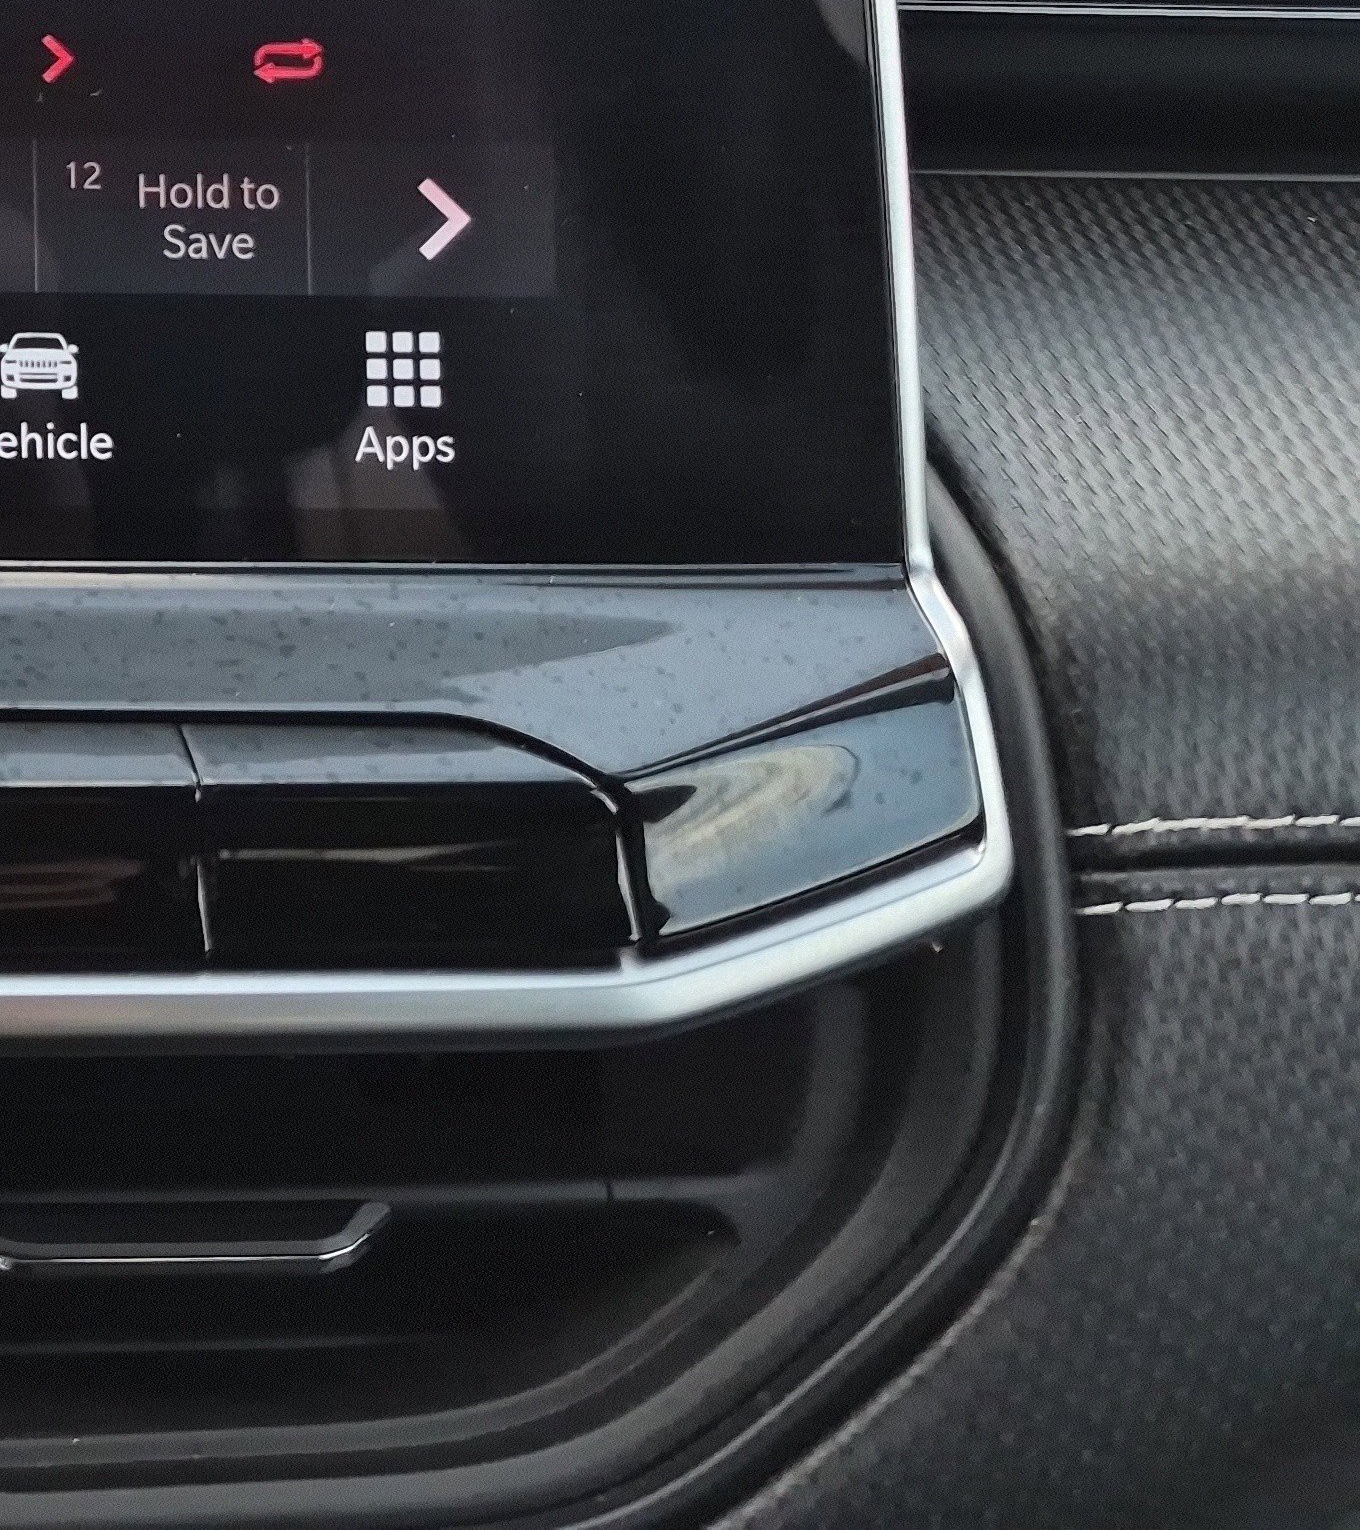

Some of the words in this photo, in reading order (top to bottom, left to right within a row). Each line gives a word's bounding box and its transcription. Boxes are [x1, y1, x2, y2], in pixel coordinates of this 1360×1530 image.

[67, 161, 102, 190] 12
[137, 172, 230, 210] Hold
[240, 176, 281, 211] to
[163, 223, 255, 260] Save
[355, 426, 455, 471] Apps
